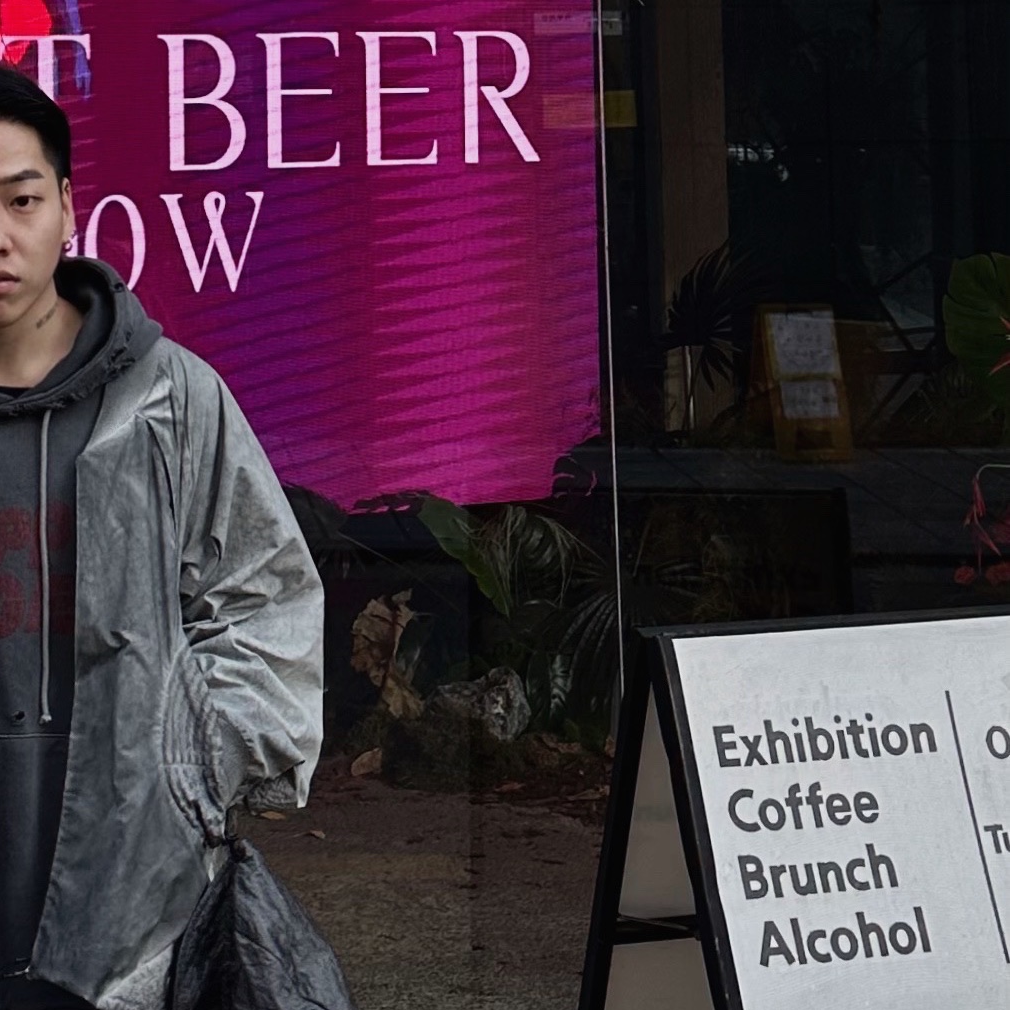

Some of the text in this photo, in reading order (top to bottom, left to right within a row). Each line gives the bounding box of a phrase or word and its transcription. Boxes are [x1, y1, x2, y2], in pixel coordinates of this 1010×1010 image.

[157, 31, 540, 171] BEER
[712, 713, 937, 768] Exhibition
[728, 781, 879, 832] Coffee
[737, 843, 899, 900] Brunch
[759, 906, 932, 967] Alcohol
